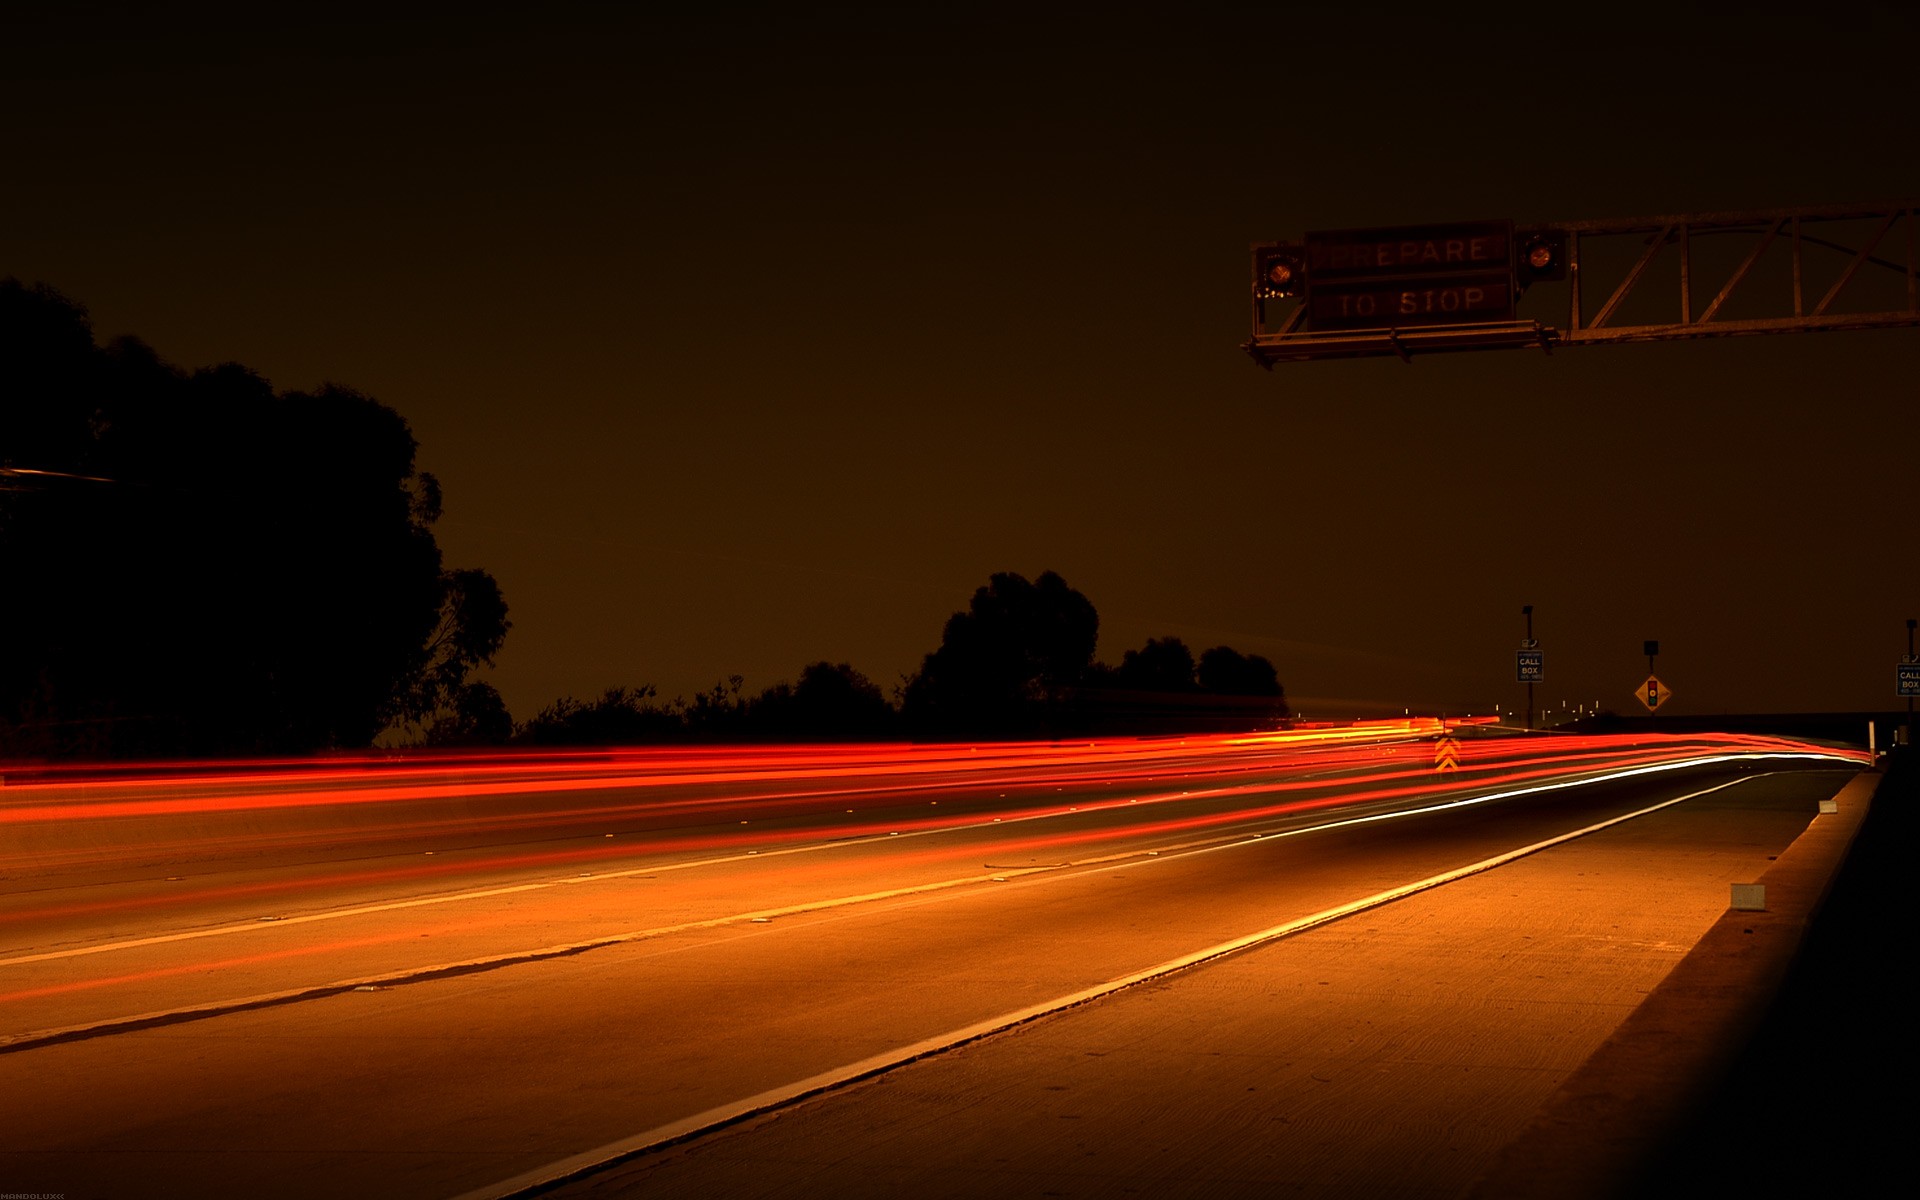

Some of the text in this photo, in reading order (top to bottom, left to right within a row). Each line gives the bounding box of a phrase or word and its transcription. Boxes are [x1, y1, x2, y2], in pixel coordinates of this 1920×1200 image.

[1330, 237, 1488, 269] PREPARE
[1339, 288, 1485, 317] TO STOP
[1519, 658, 1540, 666] CALL
[1900, 671, 1920, 679] CALL
